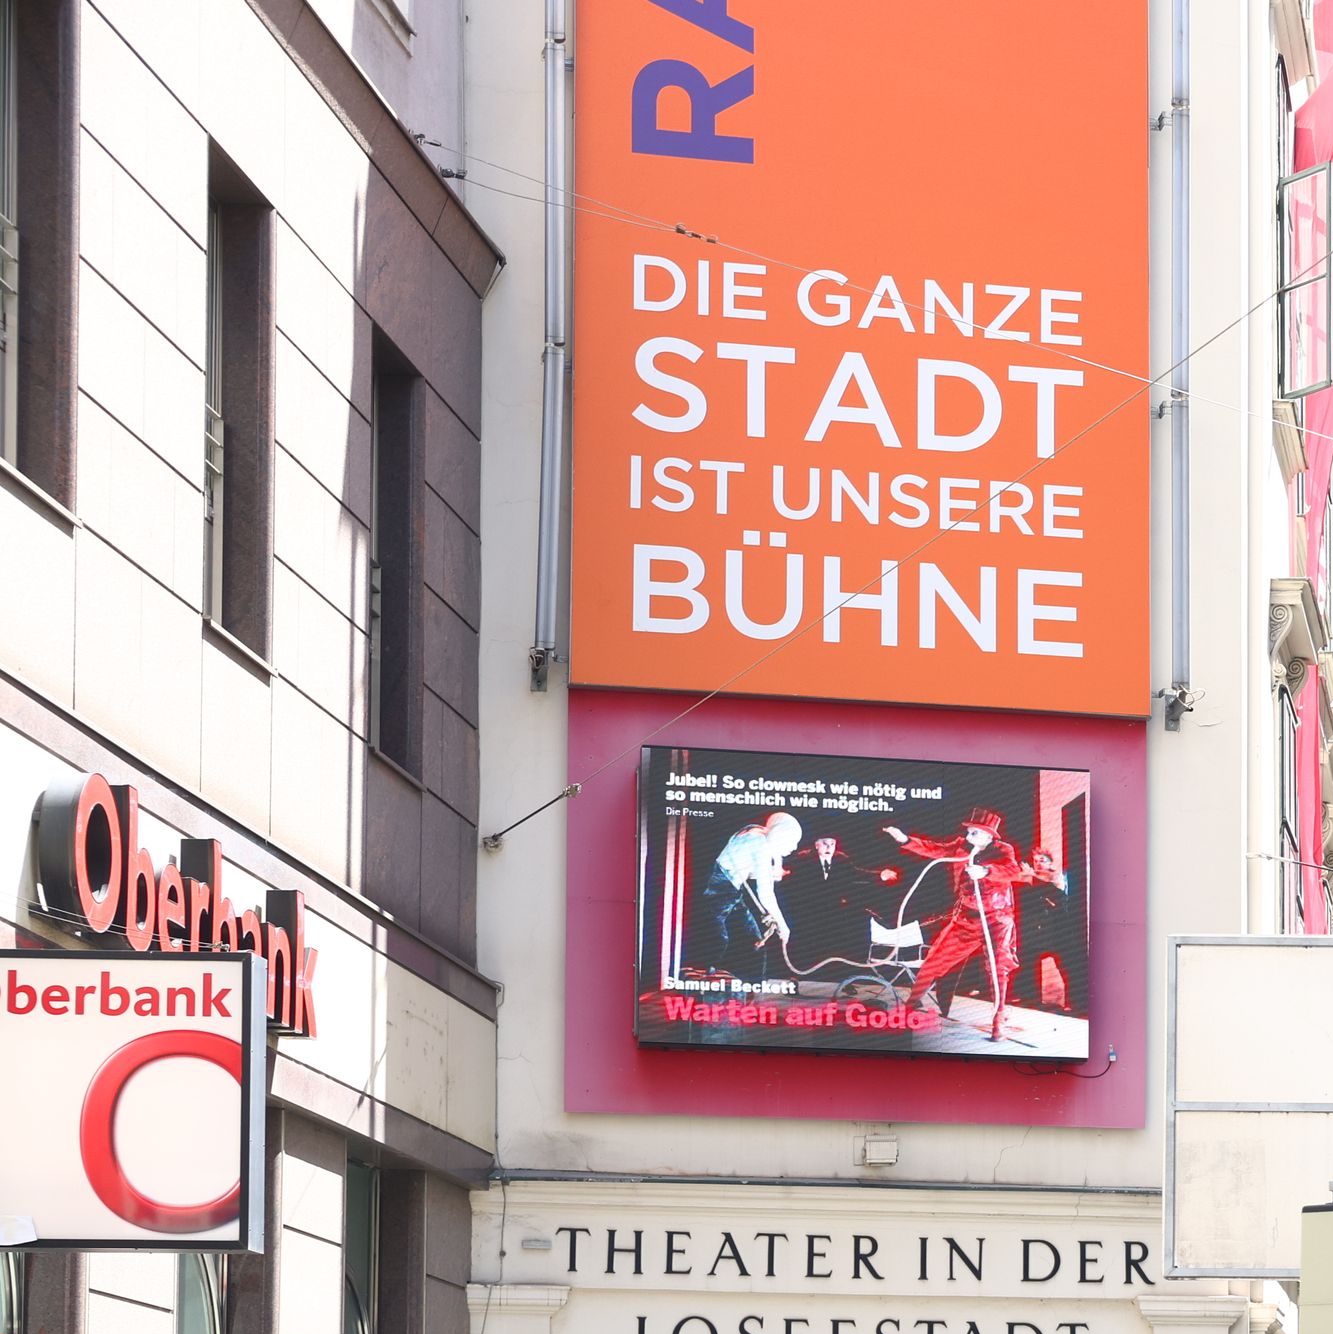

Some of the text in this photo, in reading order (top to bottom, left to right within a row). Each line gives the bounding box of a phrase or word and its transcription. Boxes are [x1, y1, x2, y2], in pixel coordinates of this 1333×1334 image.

[633, 254, 1084, 346] DIE GANZE
[631, 336, 1085, 460] STADT
[629, 454, 1084, 540] IST UNSERE
[632, 530, 1085, 658] BÜHNE
[665, 772, 943, 801] Jubel! So clownesk wie nötig und
[665, 789, 894, 814] so menschlich wie möglich.
[665, 806, 715, 818] Die Presse
[0, 969, 232, 1018] berbank
[662, 978, 797, 995] Samuel Beckett
[662, 995, 943, 1031] Warten auf Godot
[556, 1227, 1156, 1286] THEATER IN DER
